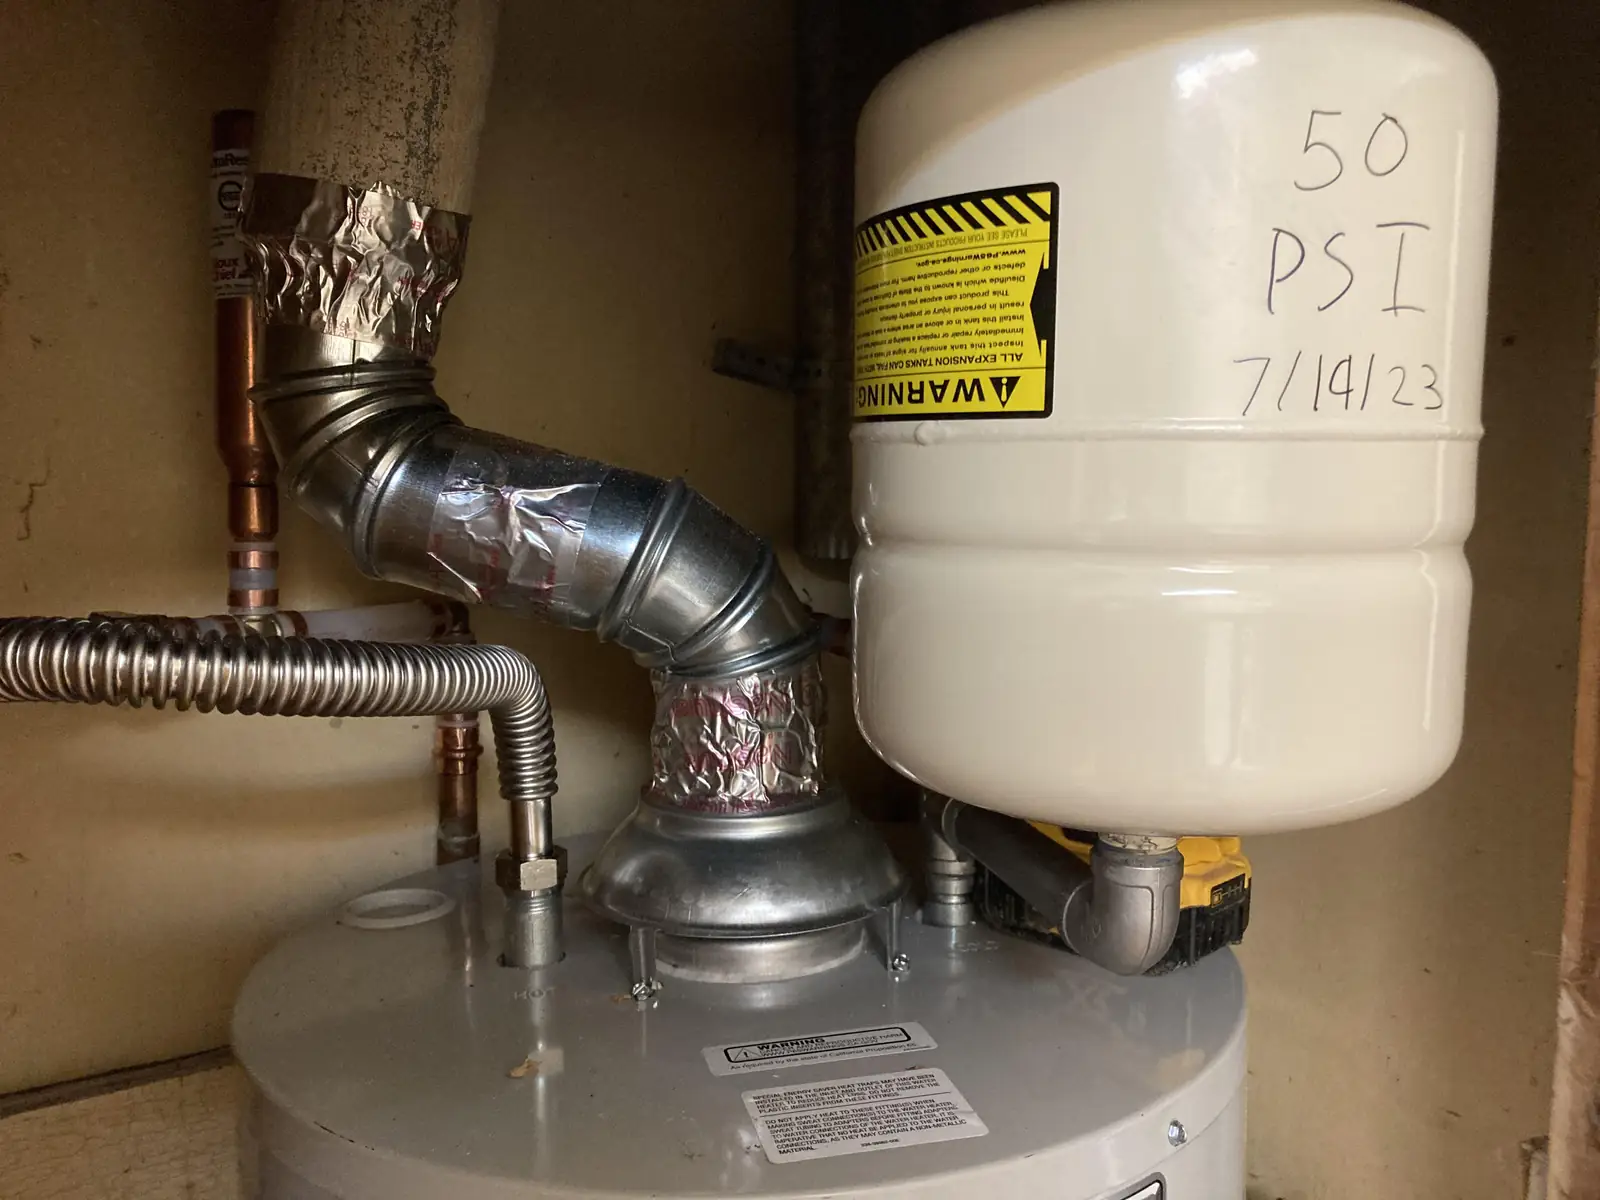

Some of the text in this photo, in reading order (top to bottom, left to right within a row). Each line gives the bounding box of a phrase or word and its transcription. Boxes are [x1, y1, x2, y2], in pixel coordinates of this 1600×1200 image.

[1294, 110, 1408, 190] 50
[967, 233, 984, 244] YOUR
[988, 231, 1000, 241] SEE
[1000, 228, 1028, 240] PLEASE
[994, 262, 1026, 270] defects
[1267, 221, 1431, 317] PSI
[917, 270, 958, 281] reproductive
[960, 267, 980, 275] other
[964, 279, 987, 288] which
[990, 276, 1025, 284] Disulfide
[960, 290, 990, 300] product
[907, 298, 919, 306] you
[919, 296, 943, 304] expose
[953, 304, 987, 314] personal
[1000, 302, 1025, 310] result
[933, 307, 952, 316] injury
[964, 318, 980, 326] tank
[1000, 315, 1024, 323] Install
[924, 321, 944, 330] above
[917, 332, 941, 341] replace
[952, 330, 973, 339] repair
[974, 327, 1024, 337] Immediately
[970, 343, 986, 351] this
[989, 340, 1024, 348] Inspect
[919, 345, 948, 355] annually
[936, 354, 997, 366] EXPANSION
[1000, 353, 1024, 362] ALL
[889, 361, 904, 370] CAN
[905, 359, 934, 368] TANKS
[759, 1038, 825, 1050] WARNING
[760, 1106, 789, 1114] PLASTIC
[791, 1102, 821, 1110] INSERTS
[768, 1122, 795, 1130] MAKING
[770, 1127, 795, 1135] SWEAT
[833, 1117, 869, 1126] ADAPTERS
[784, 1130, 809, 1138] WATER
[810, 1123, 859, 1135] CONNECTIONS
[878, 1127, 910, 1136] CONTAIN
[916, 1119, 967, 1131] NON-METALLIC
[775, 1135, 816, 1145] IMPERATIVE
[879, 1122, 909, 1130] APPLIED
